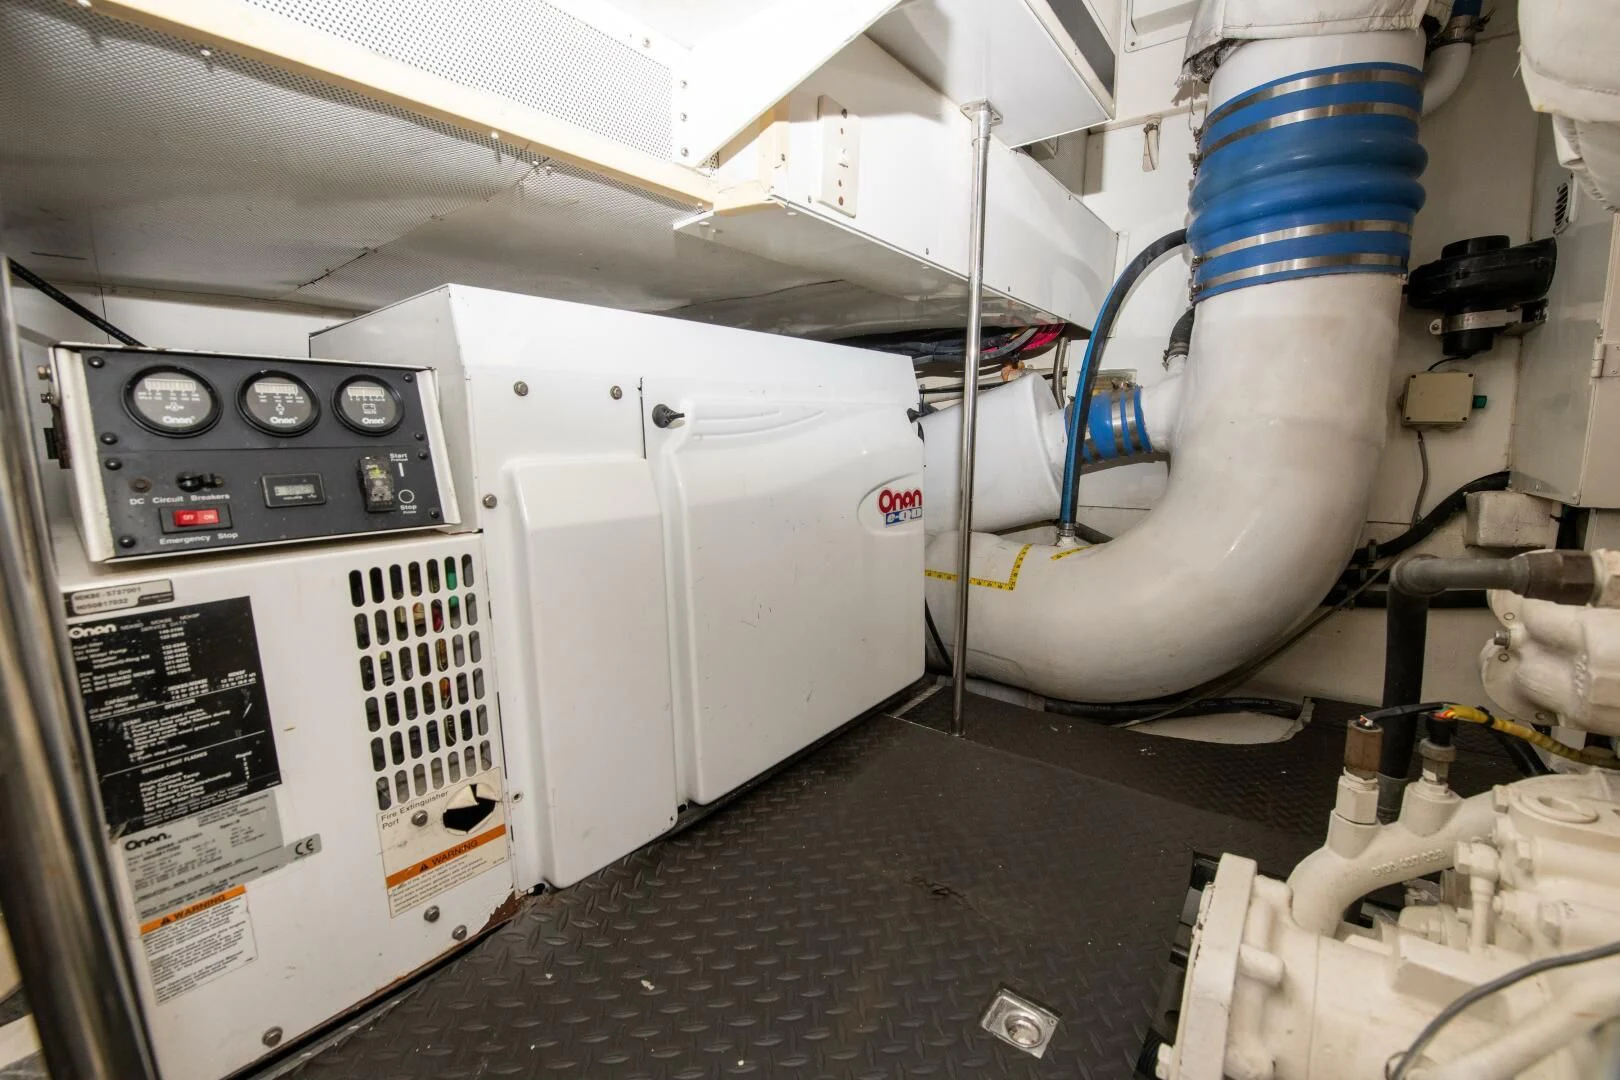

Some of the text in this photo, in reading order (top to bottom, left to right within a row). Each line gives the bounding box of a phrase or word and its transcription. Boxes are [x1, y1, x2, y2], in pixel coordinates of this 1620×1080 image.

[152, 496, 184, 504] Circuit
[190, 494, 230, 502] Breakers
[878, 489, 922, 514] Onan
[160, 534, 211, 545] Emergency
[68, 624, 117, 639] Onan
[381, 791, 448, 822] Fire Extinguisher
[382, 818, 399, 830] Port
[124, 832, 168, 850] Onan
[295, 838, 314, 855] CE
[432, 840, 478, 866] WARNING
